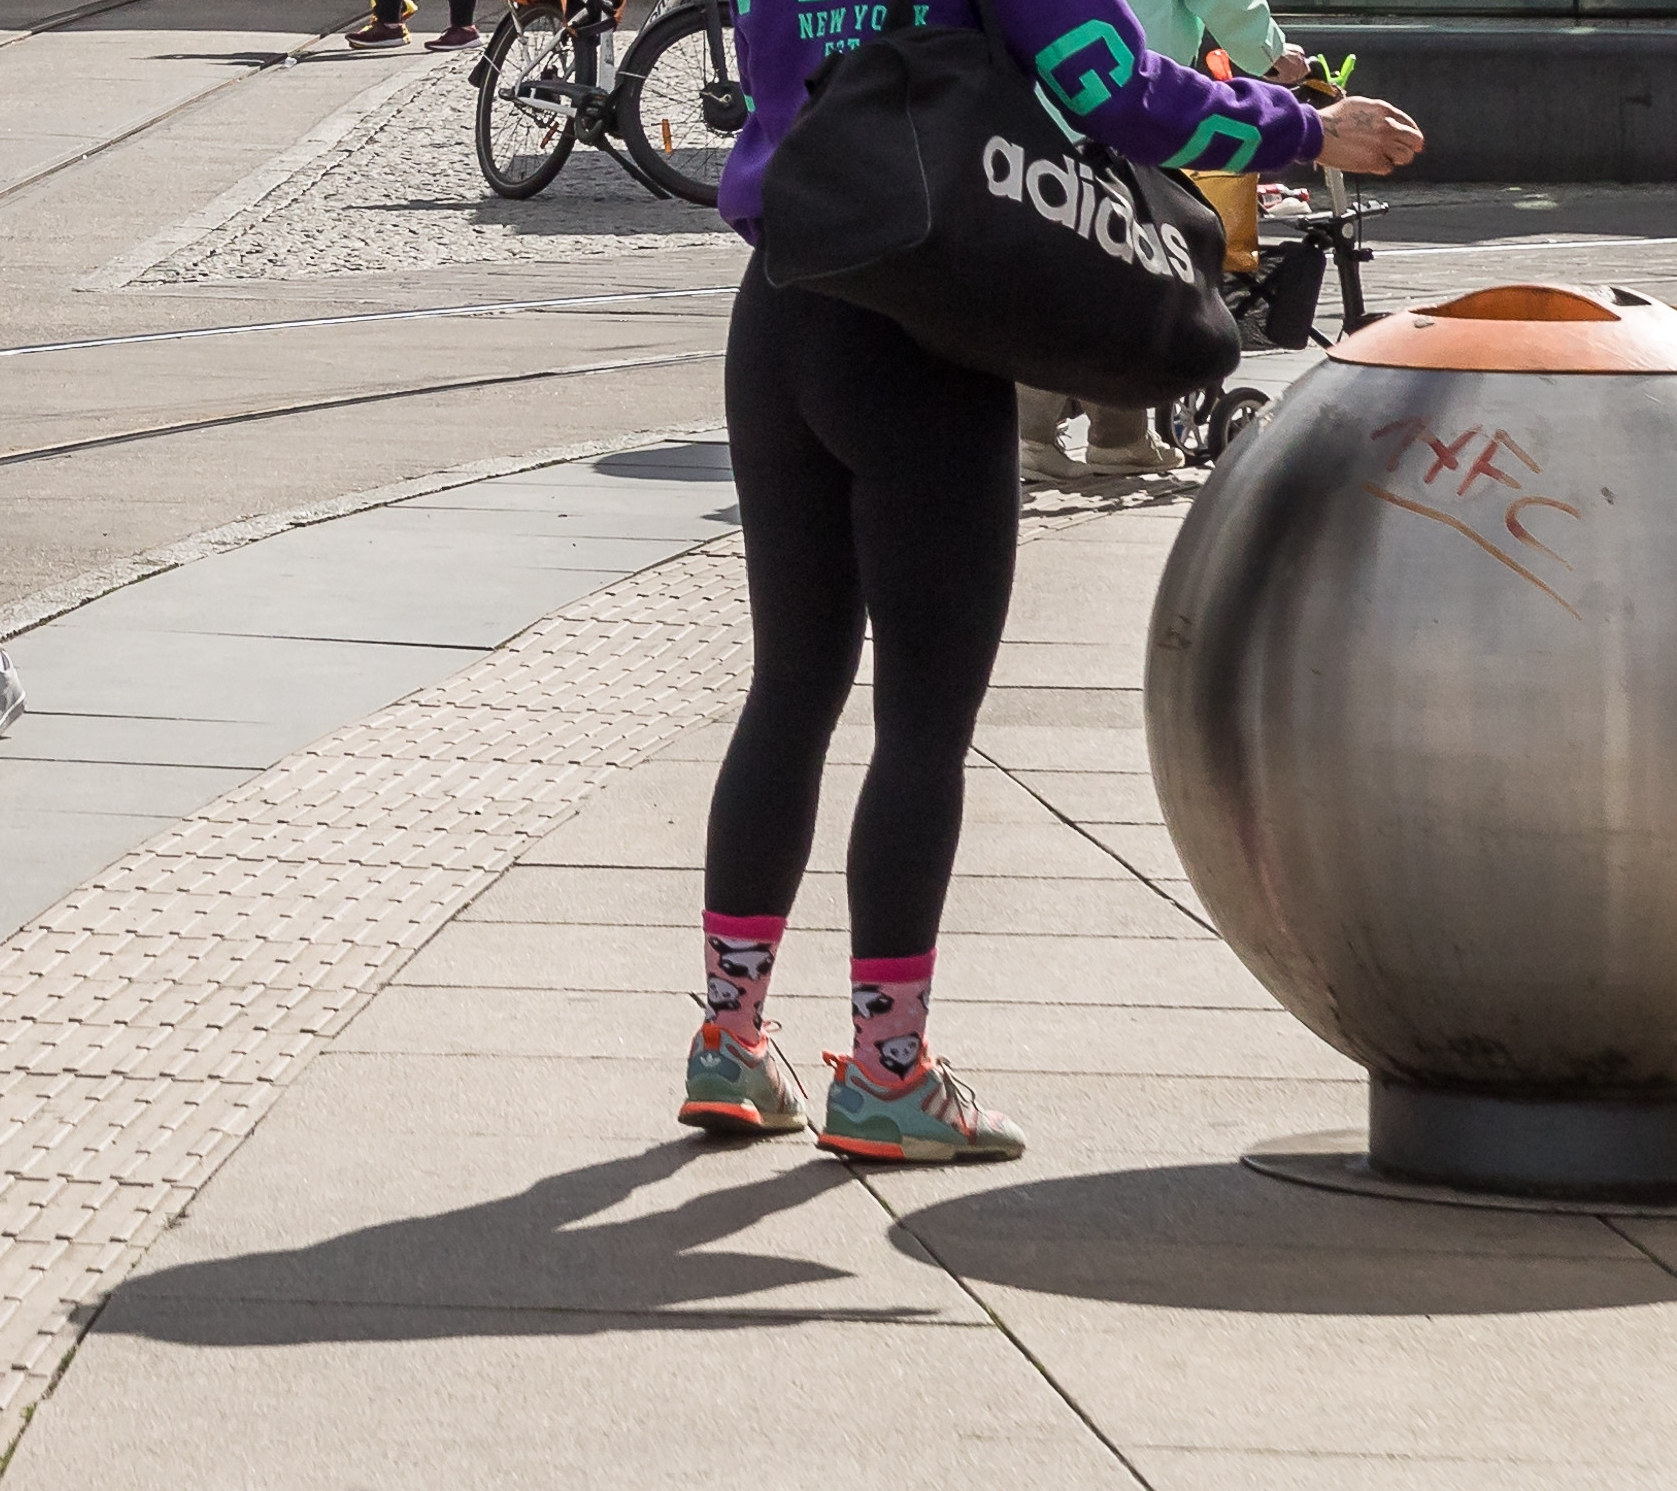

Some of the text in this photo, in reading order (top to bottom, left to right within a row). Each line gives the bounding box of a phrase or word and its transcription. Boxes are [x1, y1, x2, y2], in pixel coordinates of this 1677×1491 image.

[798, 6, 847, 41] NEW
[853, 4, 931, 33] YOK
[982, 134, 1196, 286] adidas
